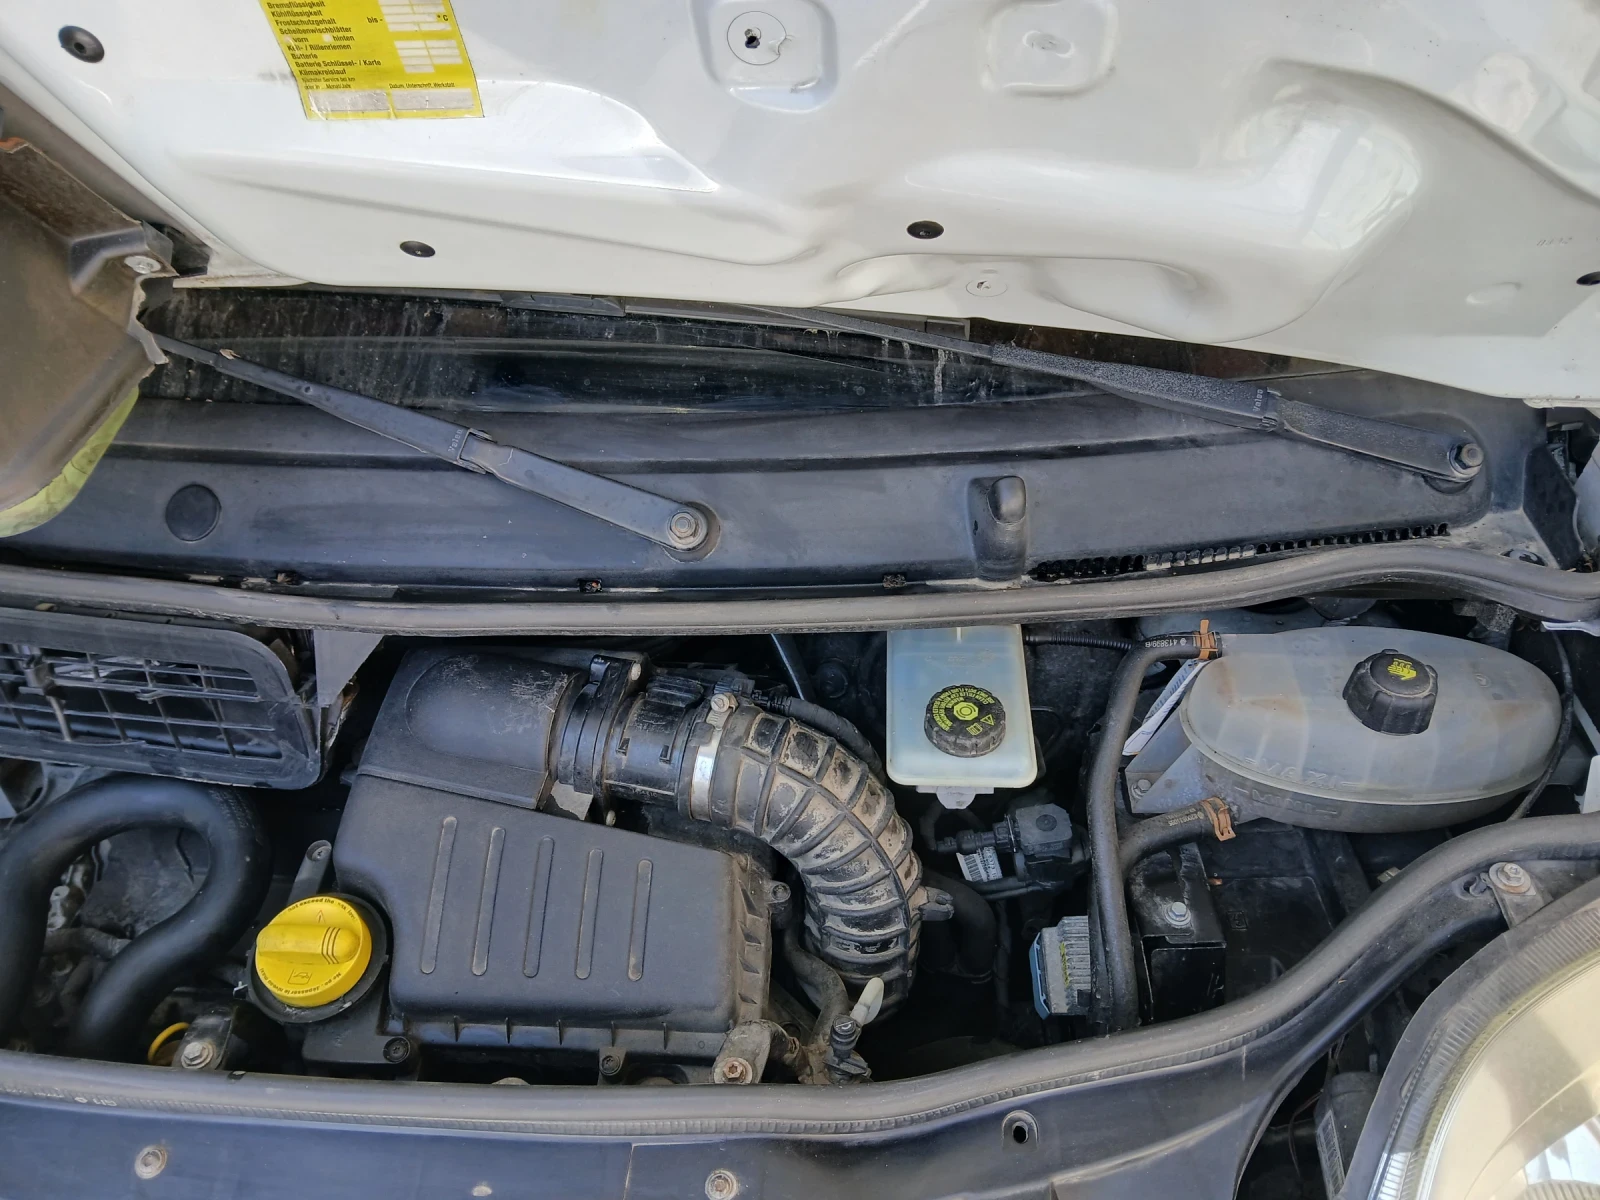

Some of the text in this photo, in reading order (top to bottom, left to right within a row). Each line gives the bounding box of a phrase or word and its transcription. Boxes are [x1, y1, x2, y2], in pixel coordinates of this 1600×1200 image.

[267, 1, 326, 9] Bremsflüssigkeit
[271, 10, 322, 18] Kühlflüssigkeit
[275, 18, 336, 26] Frostschutzgehalt
[279, 26, 352, 34] Scheibenwischblätter
[1252, 388, 1263, 412] Valeo
[448, 428, 463, 453] Valeo
[300, 898, 324, 907] exceed
